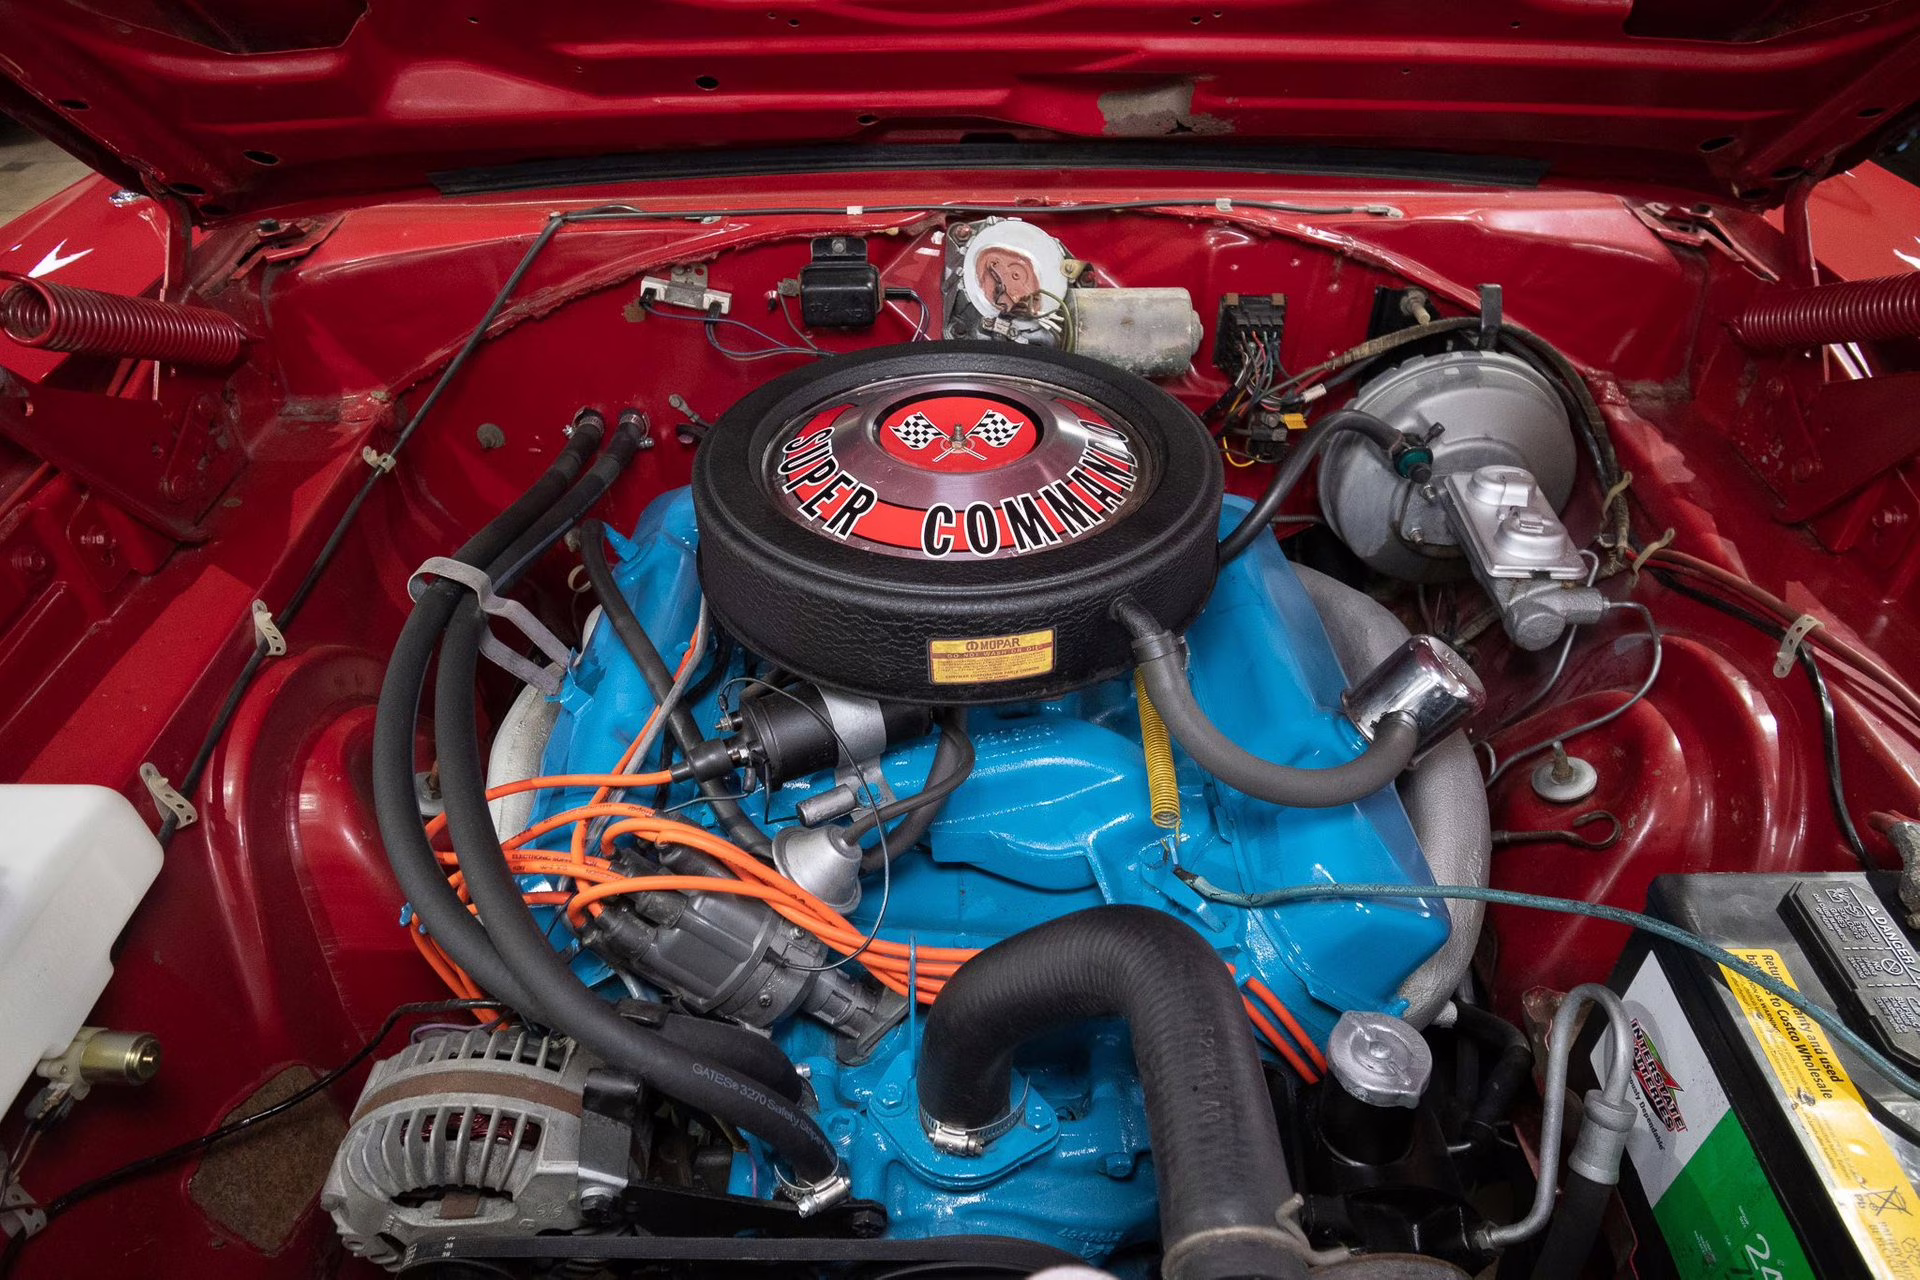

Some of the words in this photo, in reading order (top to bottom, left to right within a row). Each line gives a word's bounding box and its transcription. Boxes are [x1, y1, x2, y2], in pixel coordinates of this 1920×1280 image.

[778, 427, 878, 540] SUPER
[921, 420, 1138, 558] COMMANDO
[980, 638, 1020, 650] MOPAR
[983, 648, 1007, 656] WASH
[1874, 917, 1915, 964] DANGER
[1762, 954, 1783, 983] Retur
[1807, 1033, 1827, 1055] and
[1820, 1057, 1844, 1083] used
[1770, 996, 1782, 1007] to
[1777, 1009, 1800, 1042] Costco
[1795, 1044, 1832, 1099] Wholesale
[740, 1084, 767, 1106] 3270
[767, 1099, 799, 1127] Safety
[1631, 1019, 1686, 1131] INTERSTATE
[1633, 1045, 1674, 1131] ATTERIES
[1640, 1101, 1664, 1150] Dependable
